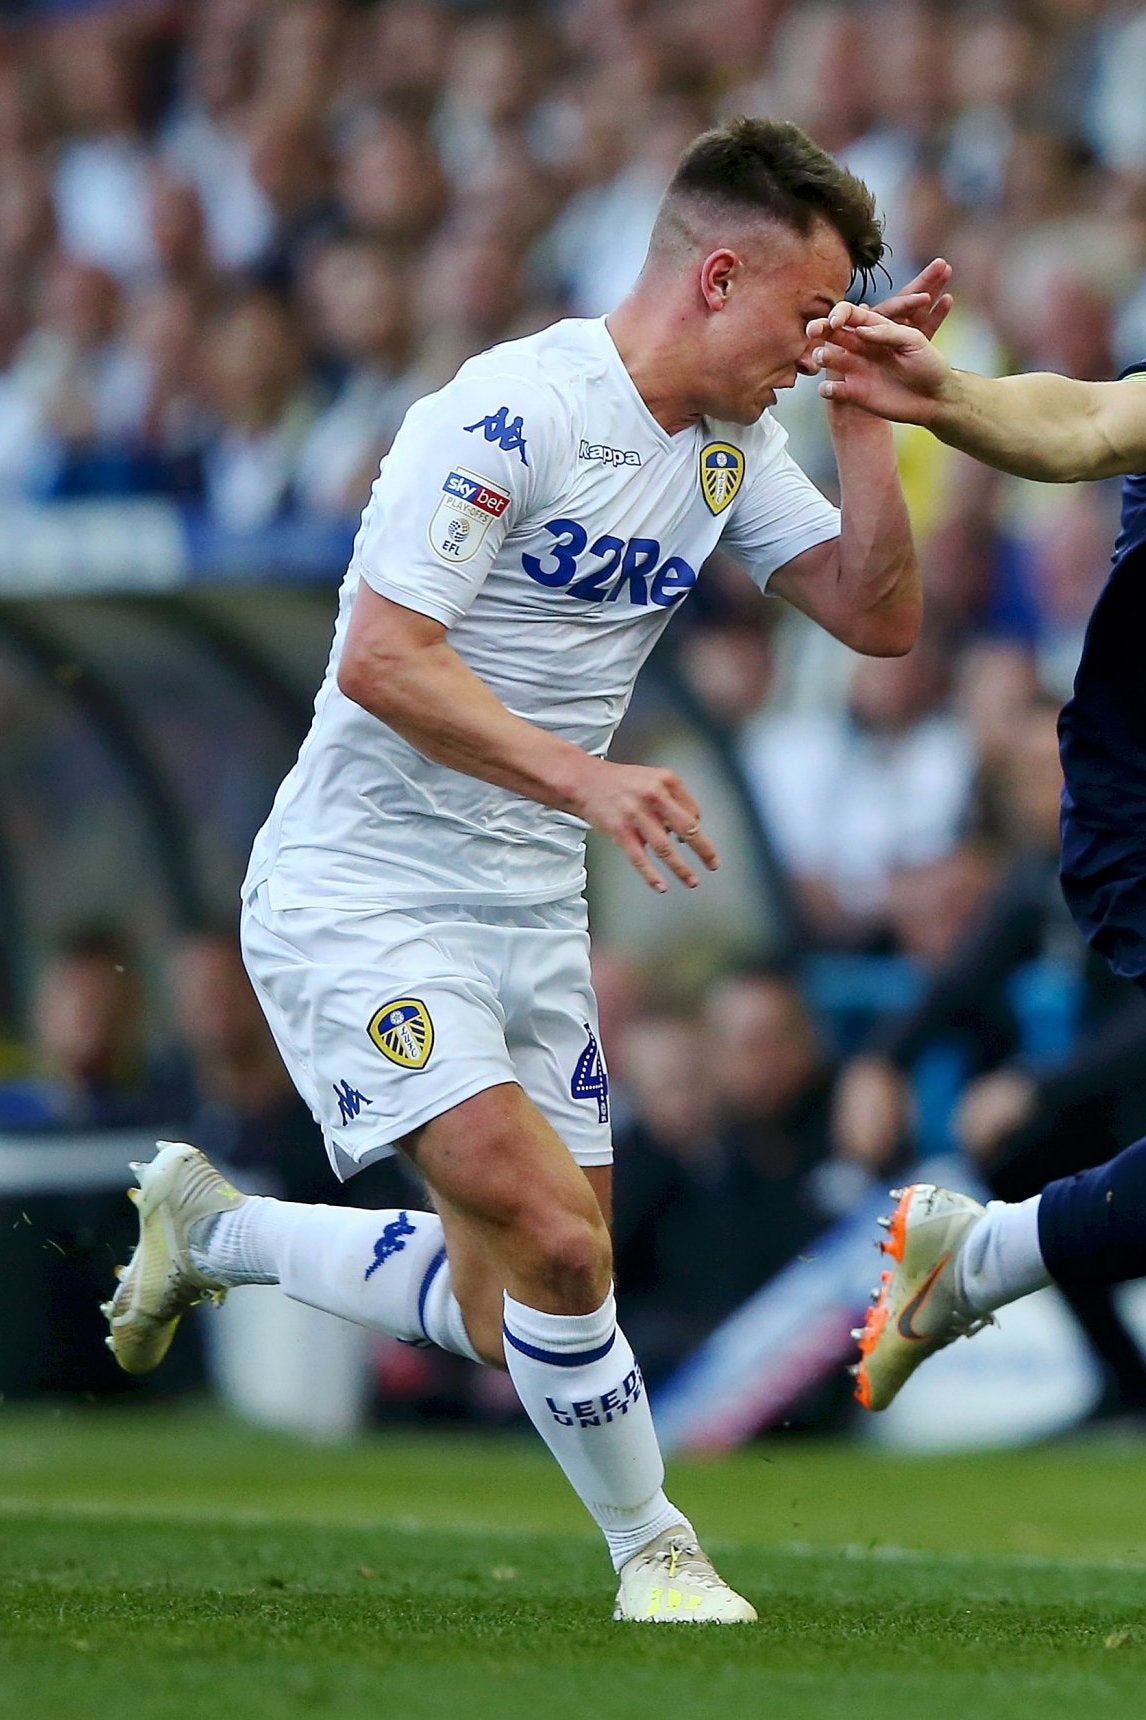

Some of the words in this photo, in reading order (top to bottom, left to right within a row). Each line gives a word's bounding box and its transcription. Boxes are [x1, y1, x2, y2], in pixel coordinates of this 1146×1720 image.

[447, 477, 477, 499] sky
[477, 489, 504, 512] bet
[442, 540, 460, 556] EFL
[571, 1022, 609, 1124] 4
